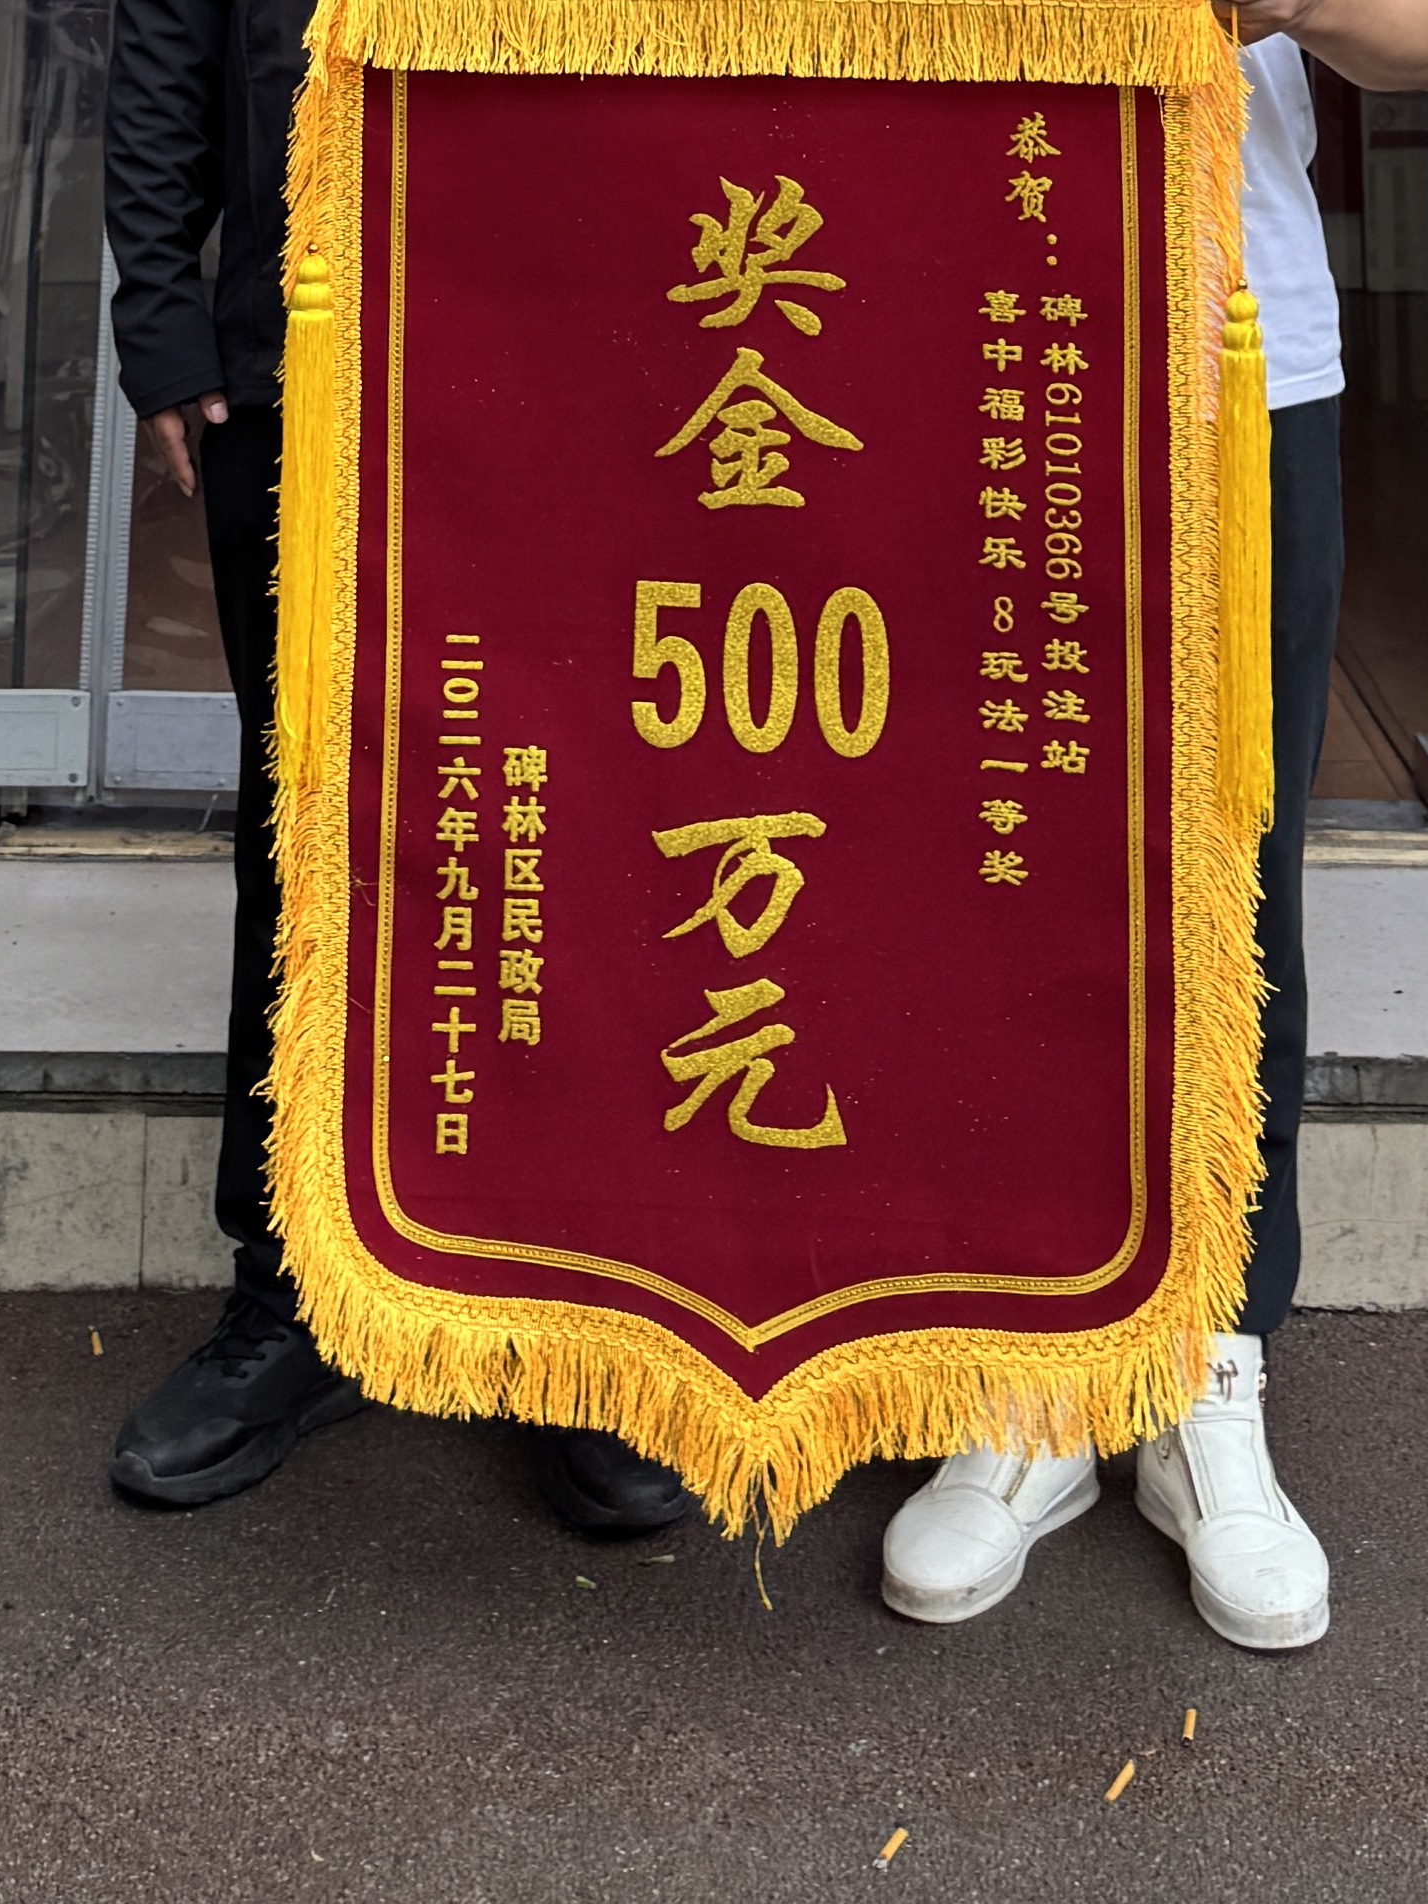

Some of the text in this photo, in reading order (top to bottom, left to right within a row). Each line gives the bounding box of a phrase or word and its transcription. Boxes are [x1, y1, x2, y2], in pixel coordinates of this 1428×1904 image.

[629, 175, 891, 1154] 奖金500万元
[978, 289, 1030, 887] 喜中福彩快乐8玩法一等奖
[1039, 292, 1091, 777] 碑林61010366号投注站
[498, 746, 549, 1047] 碑林区民政局
